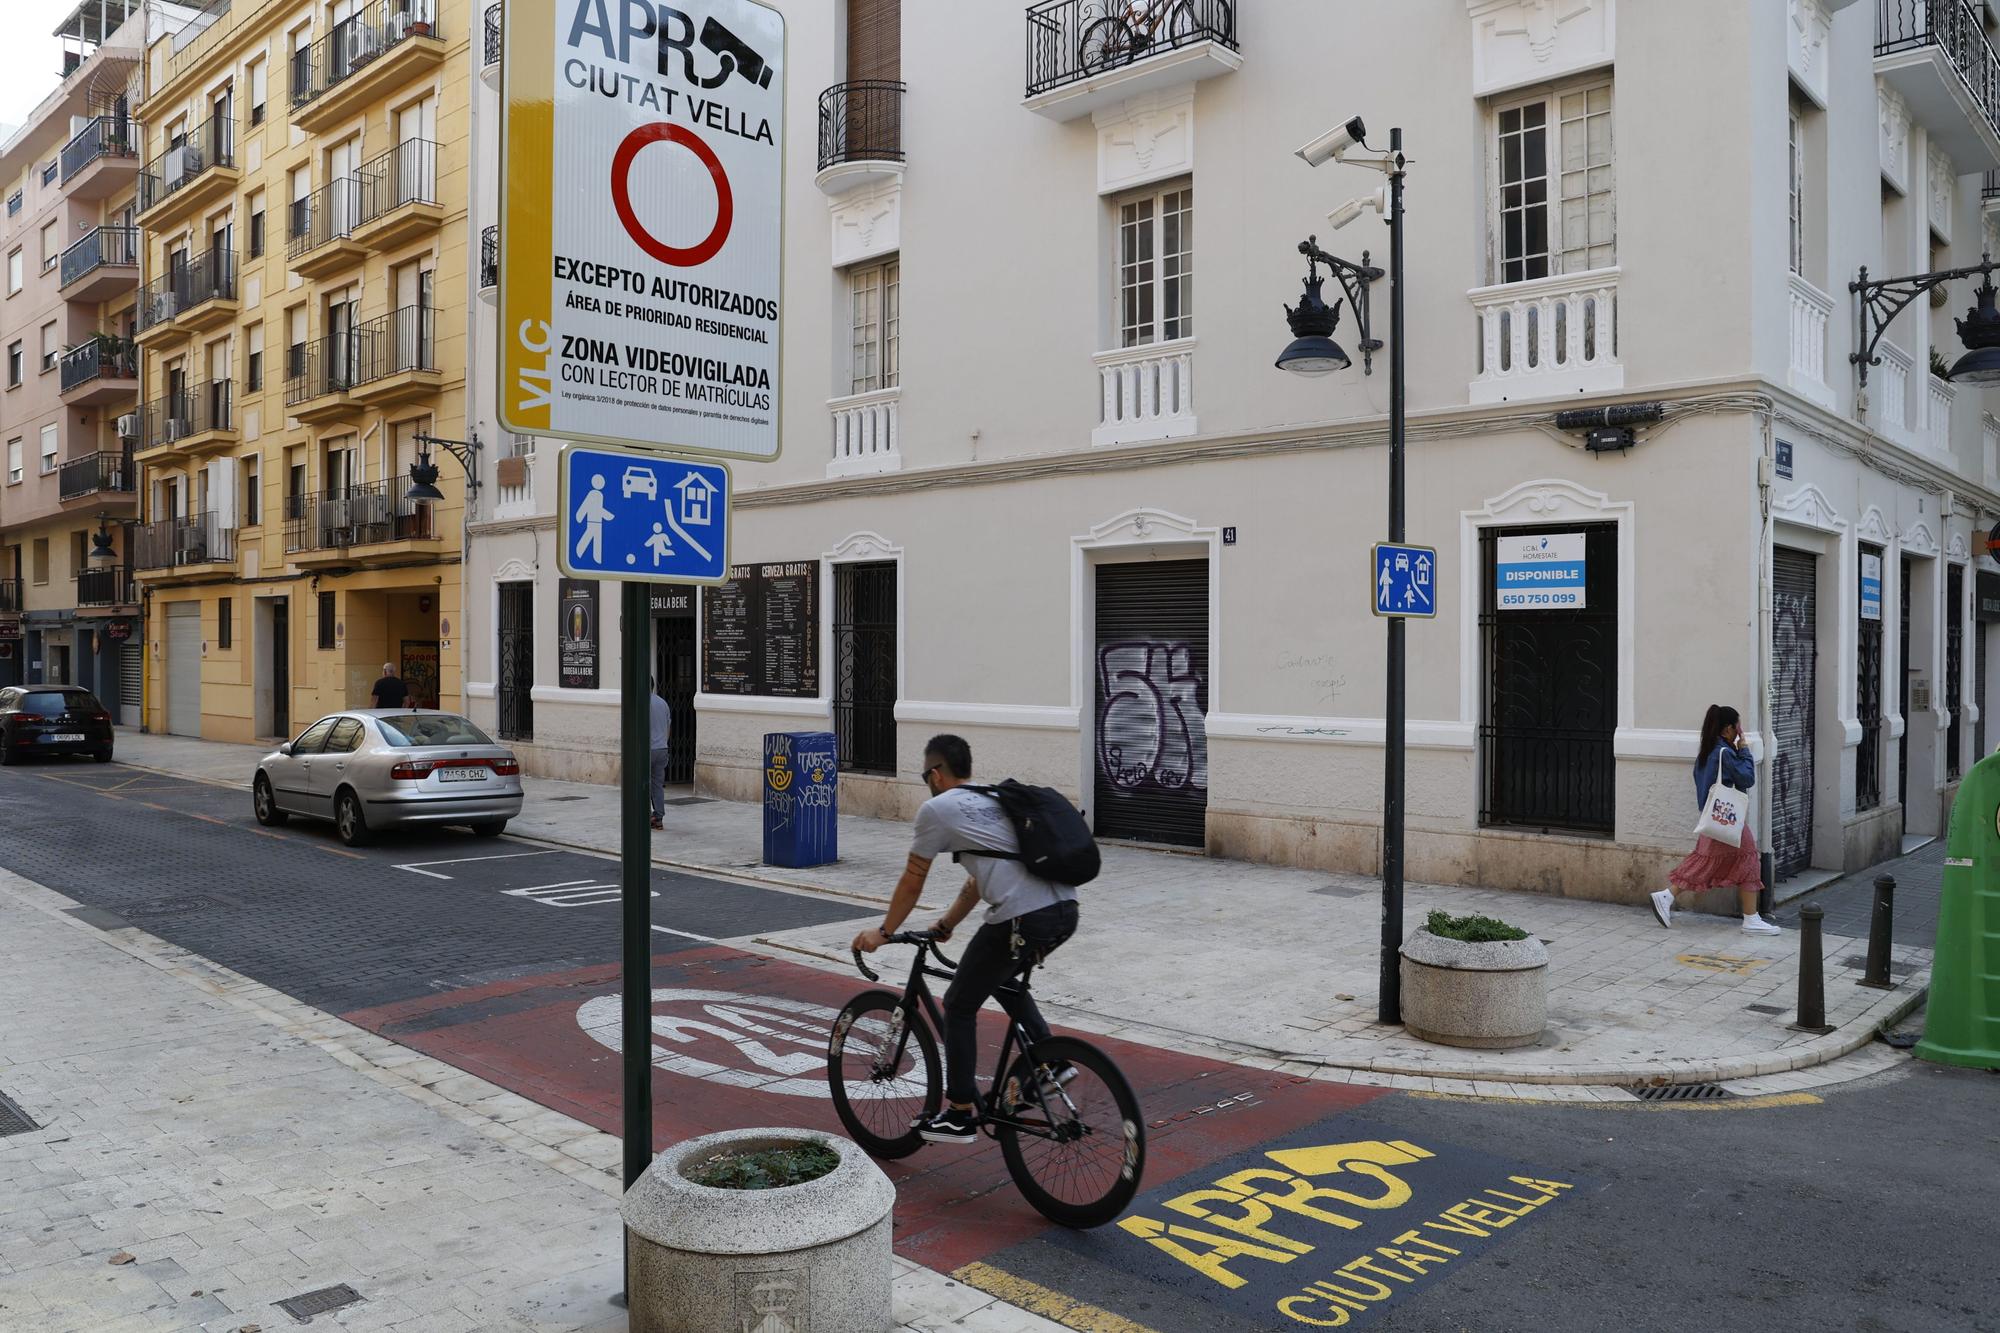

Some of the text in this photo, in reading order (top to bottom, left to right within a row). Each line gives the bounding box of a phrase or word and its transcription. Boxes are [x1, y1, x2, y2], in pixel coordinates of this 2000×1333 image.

[567, 0, 699, 87] APR
[564, 59, 774, 146] CIUTAT VELLA
[554, 256, 778, 321] EXCEPTO AUTORIZADOS
[566, 291, 768, 344] ÁREA DE PRIORIDAD RESIDENCIAL
[518, 318, 552, 411] VLC
[561, 335, 771, 390] ZONA VIDEOVIGILADA
[561, 363, 770, 411] CON LECTOR DE MATRÍCULAS
[572, 392, 596, 402] orgánica
[624, 400, 650, 410] protección
[672, 407, 698, 416] personales
[730, 414, 750, 423] derechos
[751, 416, 769, 426] digitales
[1225, 528, 1235, 542] 41
[762, 564, 807, 578] CERVEZA GRATIS
[1506, 570, 1578, 581] DISPONIBLE
[663, 597, 670, 608] LA
[672, 596, 687, 608] BENE
[1503, 594, 1576, 604] 650 750 099
[469, 769, 485, 778] CHZ
[1116, 1166, 1395, 1290] APR
[1276, 1175, 1574, 1328] CIUTAT VELLA
